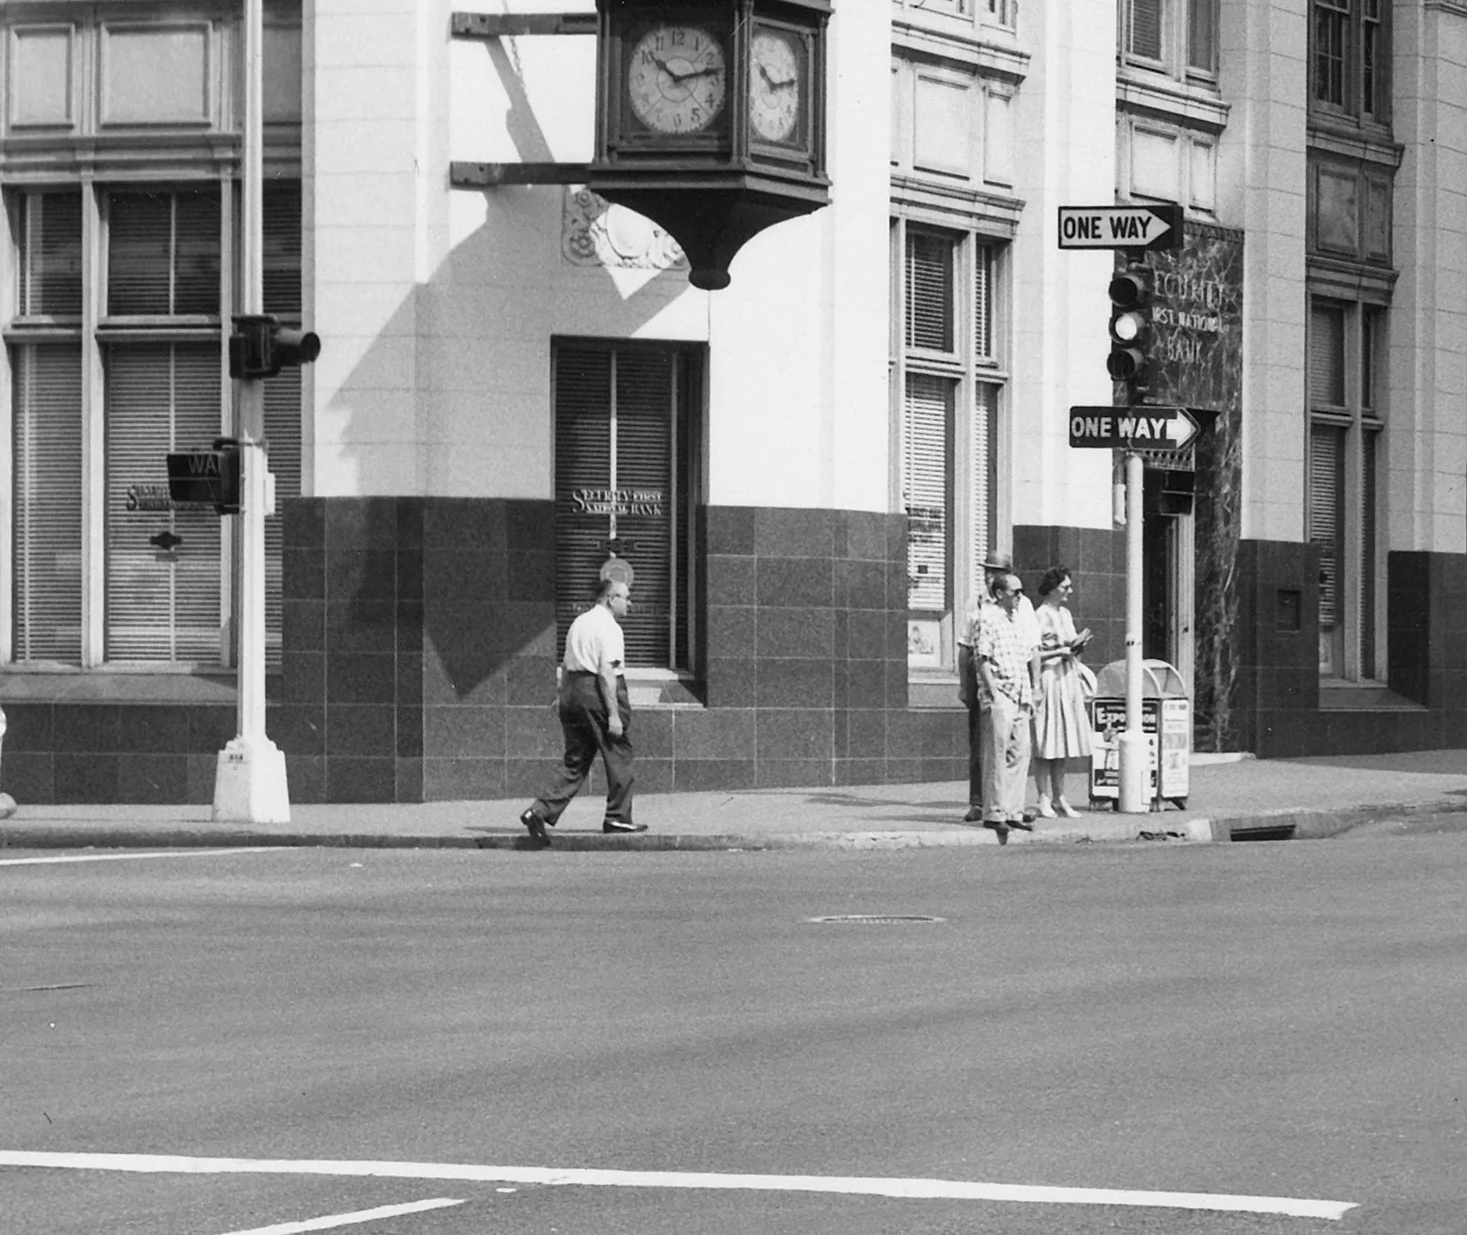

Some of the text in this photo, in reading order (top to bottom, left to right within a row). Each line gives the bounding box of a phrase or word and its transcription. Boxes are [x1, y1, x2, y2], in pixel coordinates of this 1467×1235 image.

[1063, 216, 1153, 240] ONE WAY
[1153, 270, 1226, 310] ECURITY
[1071, 417, 1167, 440] ONE WAY
[187, 452, 220, 475] WA
